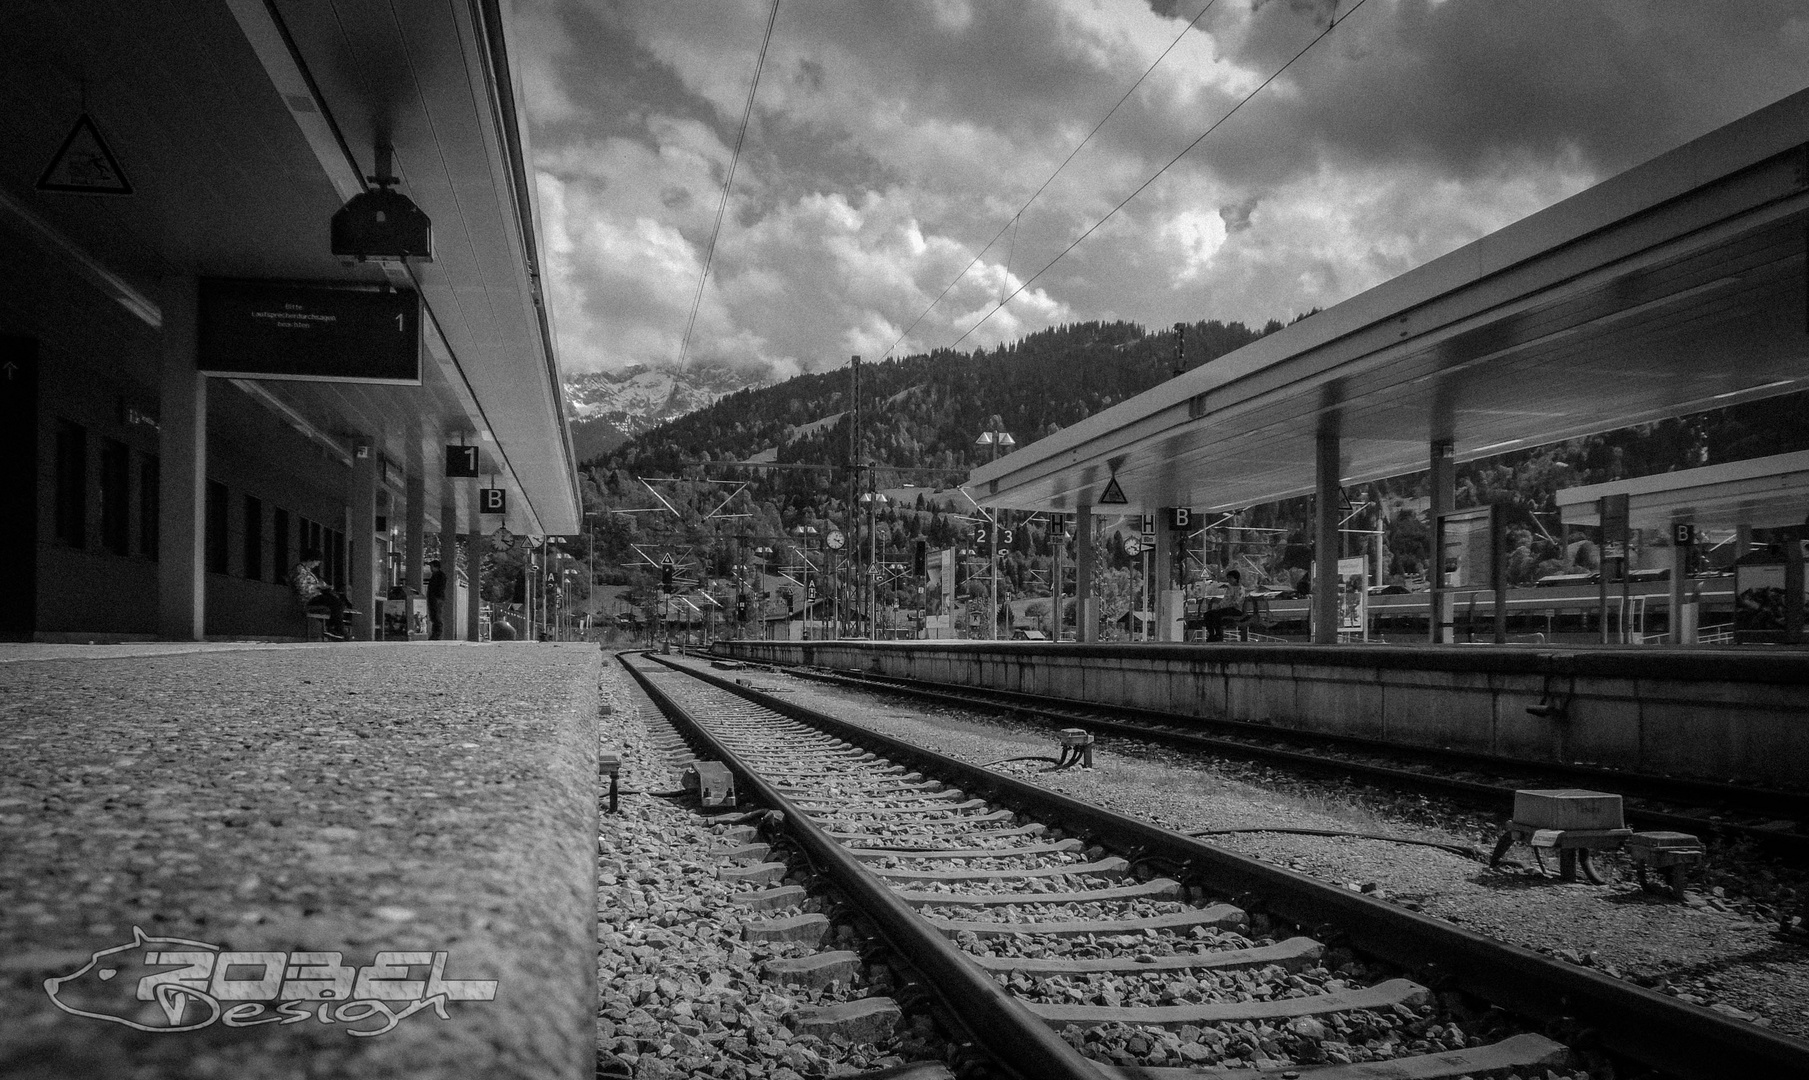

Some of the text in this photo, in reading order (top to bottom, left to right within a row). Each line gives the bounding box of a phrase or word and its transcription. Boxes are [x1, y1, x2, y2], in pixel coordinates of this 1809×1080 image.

[395, 313, 404, 332] 1
[464, 447, 476, 471] 1
[488, 489, 502, 508] B
[1051, 513, 1063, 533] H
[1143, 514, 1155, 533] H
[1176, 508, 1189, 526] B
[976, 529, 986, 543] 2
[1004, 530, 1013, 544] 3
[1678, 525, 1688, 542] B
[547, 572, 555, 582] A
